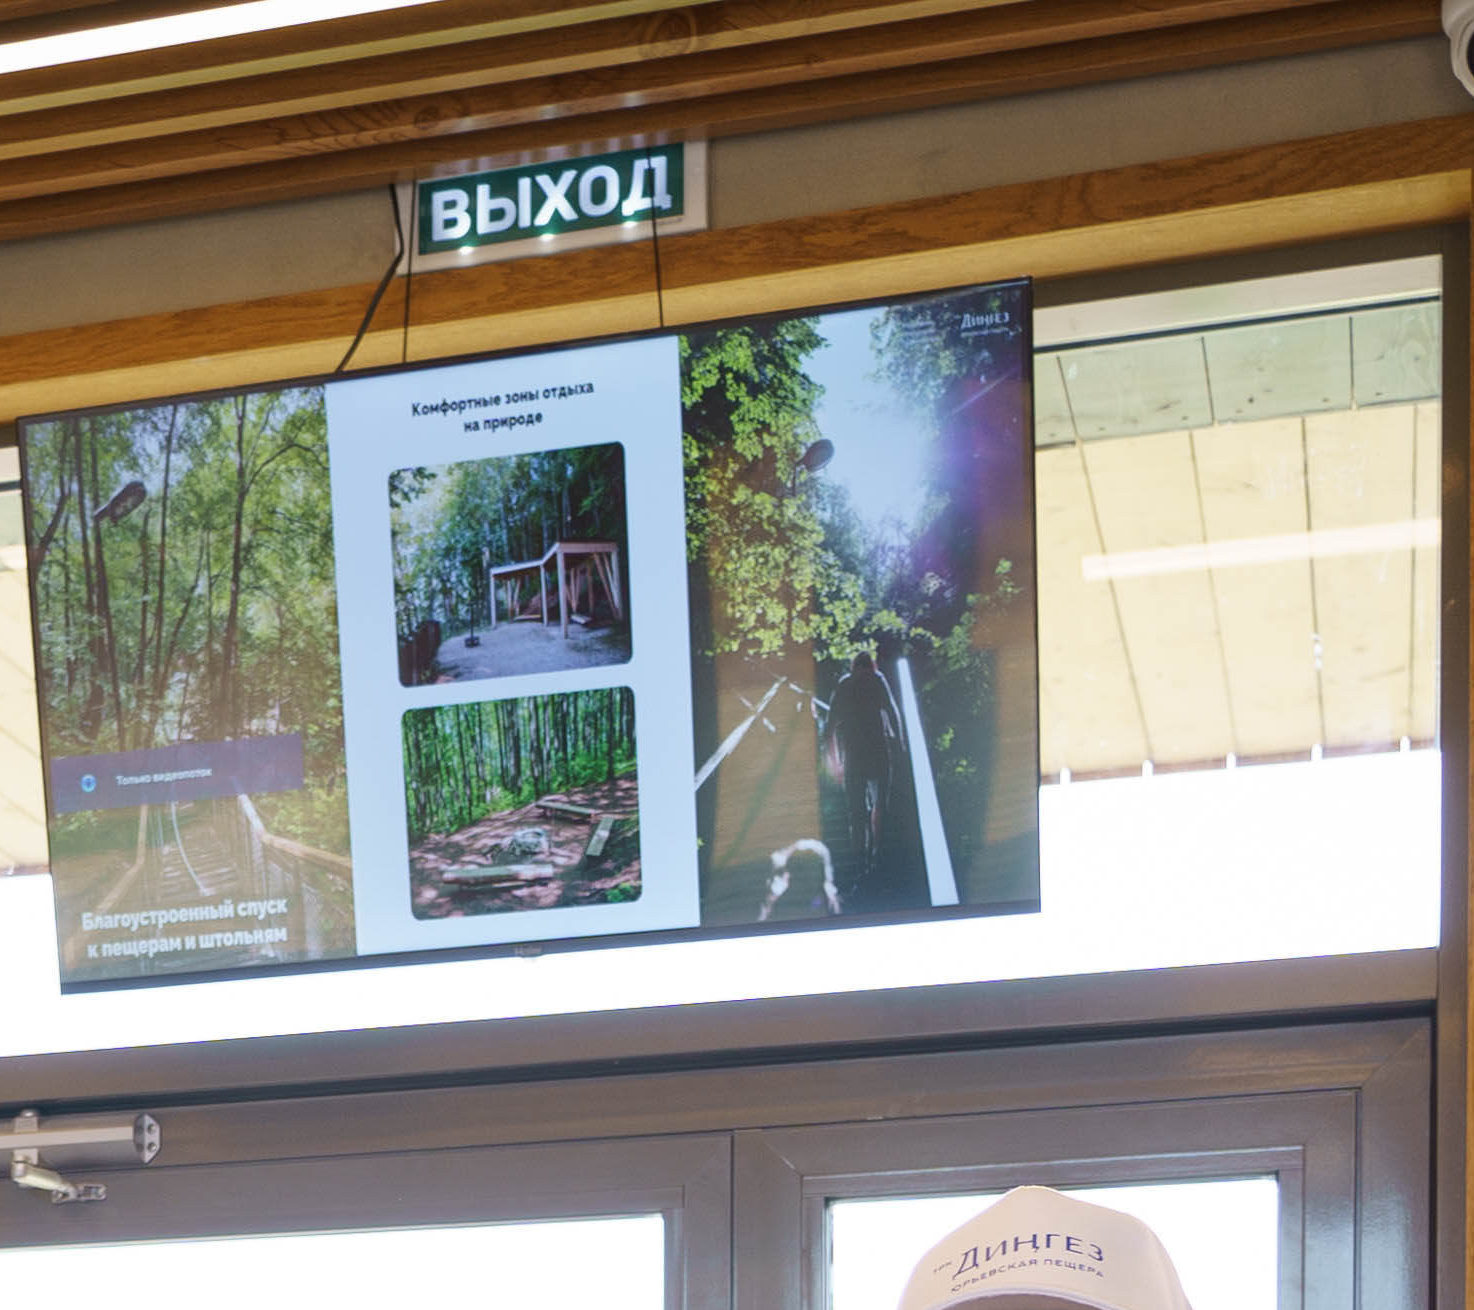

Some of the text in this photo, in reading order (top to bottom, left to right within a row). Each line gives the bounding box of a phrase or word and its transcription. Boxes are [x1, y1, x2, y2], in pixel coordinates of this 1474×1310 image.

[431, 155, 672, 243] ВЫХОД
[411, 381, 595, 418] Комфортные зоны отдыха
[463, 410, 543, 432] на природе
[81, 897, 288, 932] Благоустроенный спуск
[87, 926, 288, 959] к пещерам и штольням
[950, 1258, 1105, 1292] ЮРЬЕВСКАЯ ПЕЩЕРА
